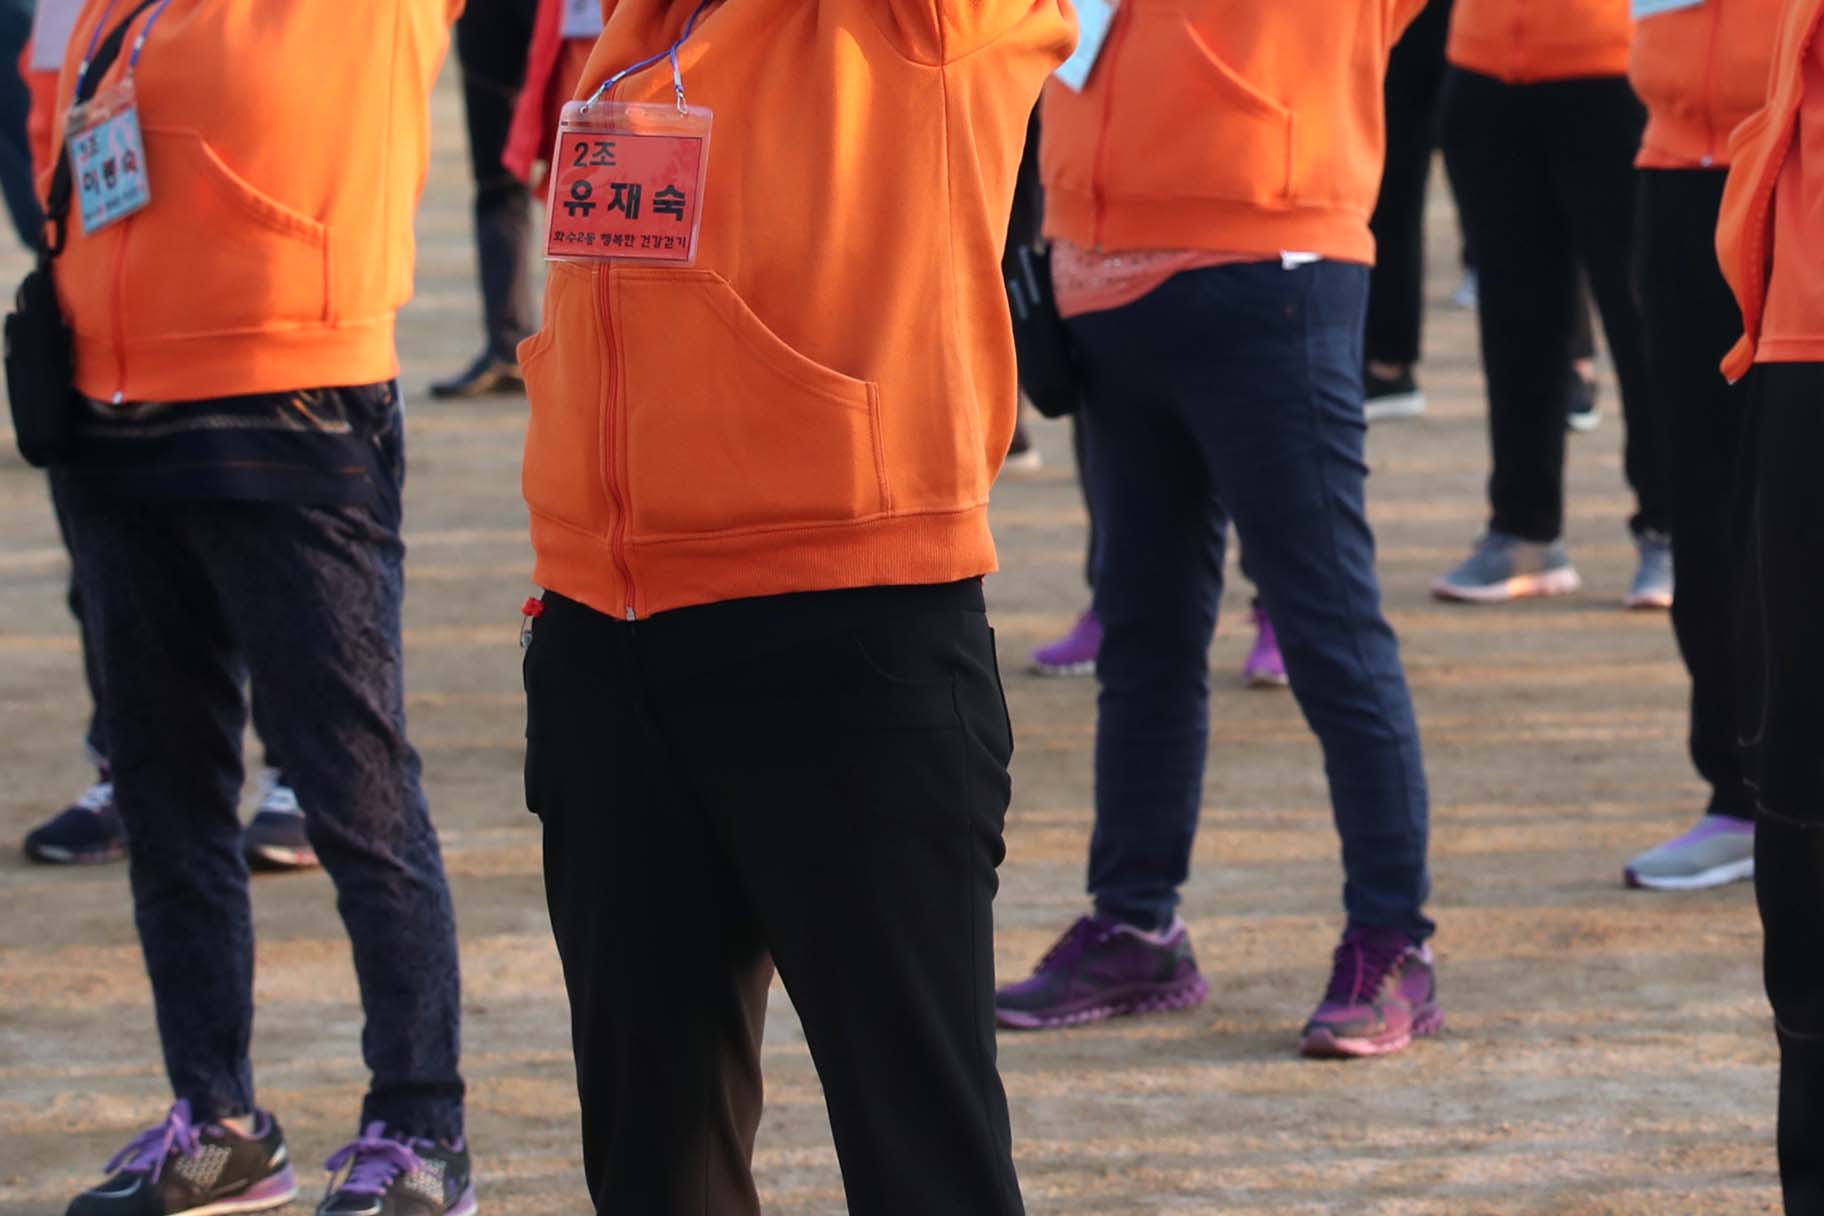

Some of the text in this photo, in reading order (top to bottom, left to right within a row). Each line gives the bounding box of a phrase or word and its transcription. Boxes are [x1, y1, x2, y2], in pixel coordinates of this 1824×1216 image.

[574, 141, 616, 169] 2조
[563, 179, 687, 222] 유재숙
[553, 230, 687, 250] 화수2동 행복한 건강걷기
